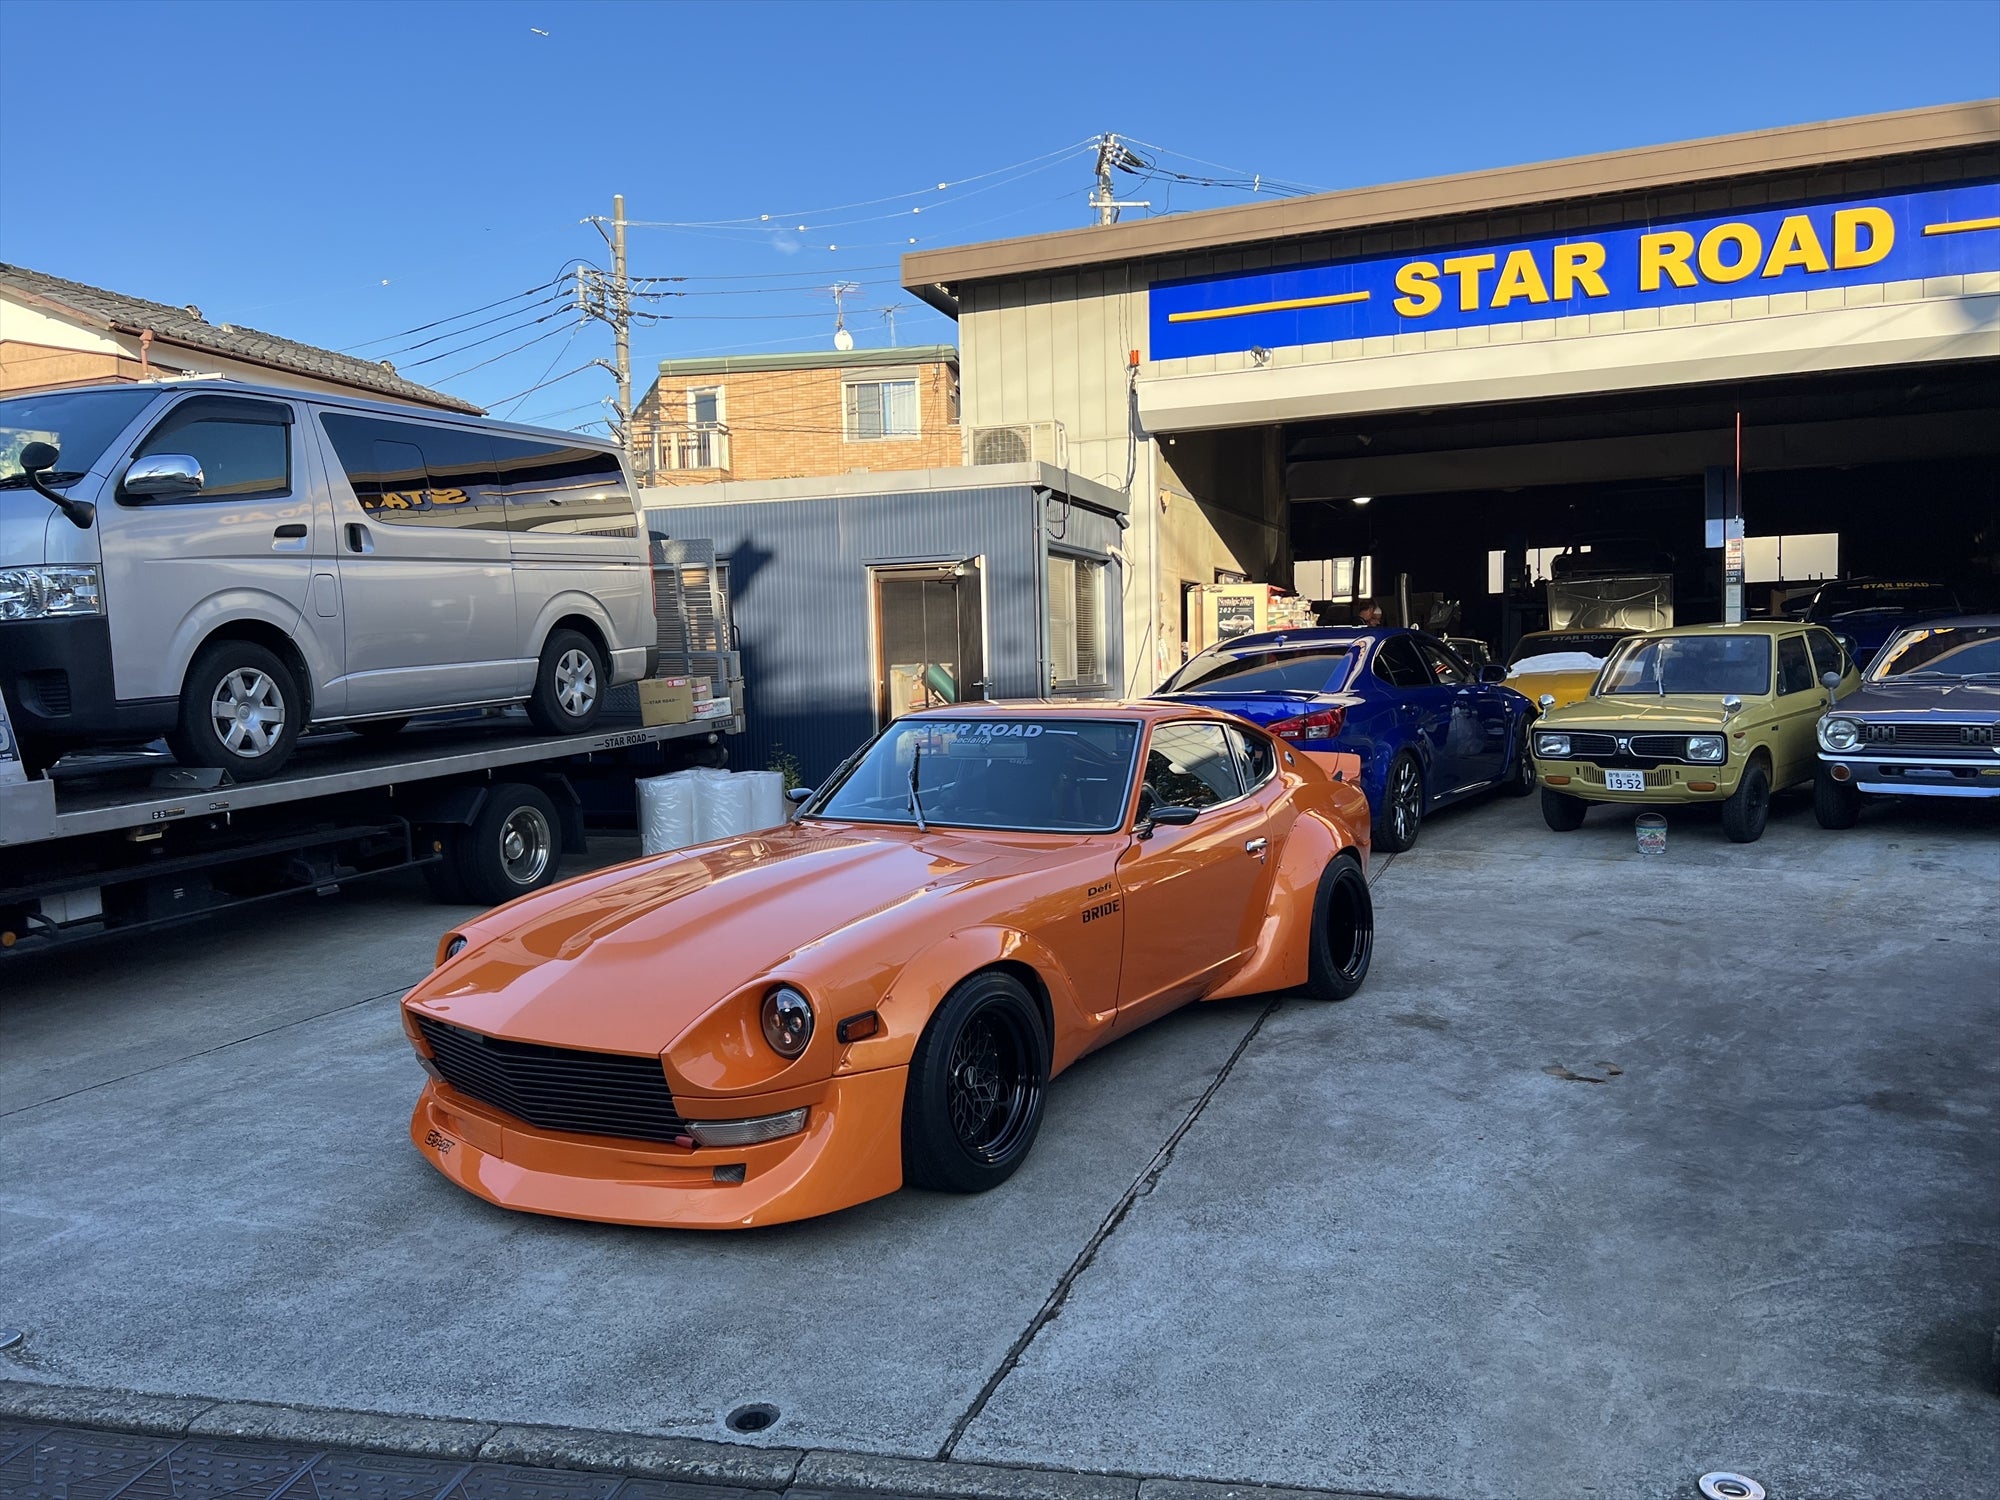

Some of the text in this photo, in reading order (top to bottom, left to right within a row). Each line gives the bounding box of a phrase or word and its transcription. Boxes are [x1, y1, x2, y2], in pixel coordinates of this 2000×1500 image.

[1393, 206, 1895, 318] STAR ROAD
[975, 724, 1043, 737] ROAD
[604, 733, 647, 748] STAR ROAD
[1609, 778, 1642, 790] 19-52
[1088, 881, 1112, 896] Defi
[1081, 899, 1120, 923] BRIDE
